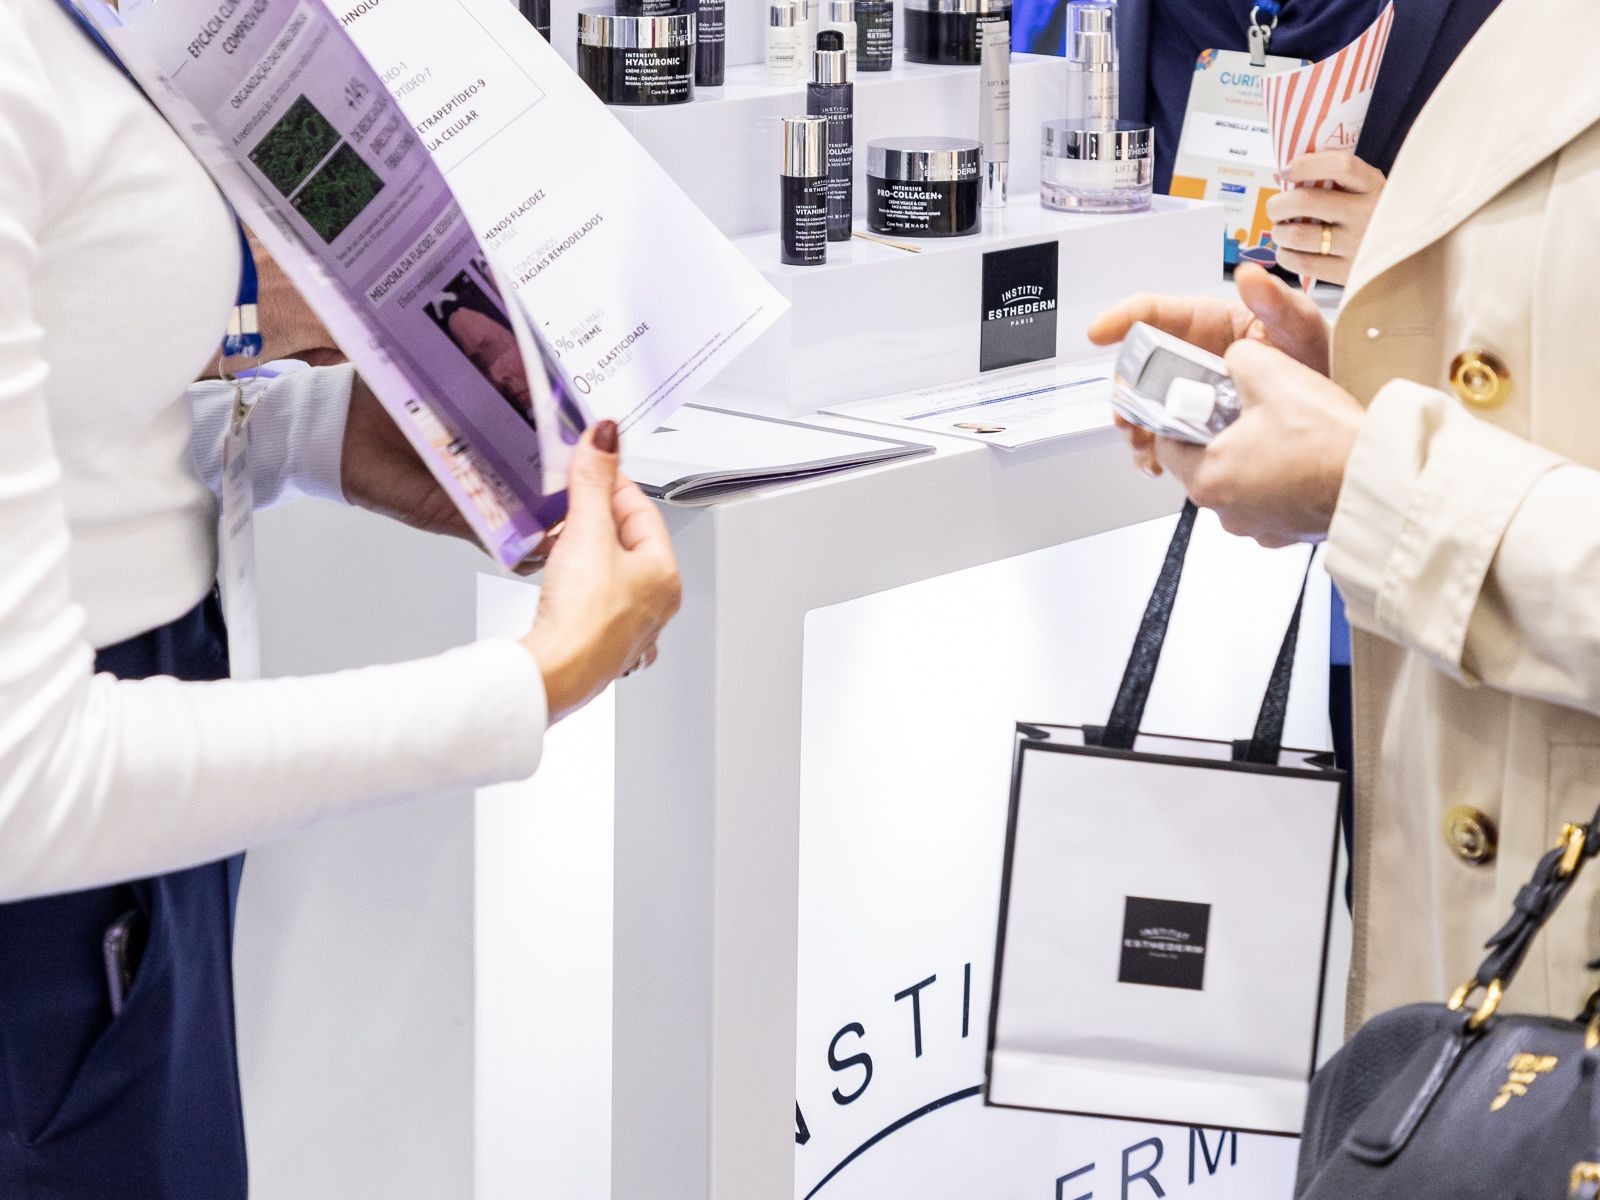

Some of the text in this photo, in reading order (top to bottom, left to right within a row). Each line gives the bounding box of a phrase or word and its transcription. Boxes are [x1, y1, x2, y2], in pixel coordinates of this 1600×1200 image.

[187, 14, 225, 58] EFICÁCIA
[625, 57, 680, 66] HYALURONIC
[230, 60, 272, 109] ORGANIZAÇÃO
[441, 110, 479, 141] CELULAR
[877, 189, 943, 200] PRO-COLLAGEN+
[483, 216, 512, 243] MENOS
[510, 189, 546, 220] FLACIDEZ
[520, 213, 603, 285] FACIAIS REMODELADOS
[369, 264, 405, 302] MELHORA
[1002, 285, 1043, 302] INSTITUT
[988, 299, 1056, 320] ESTHEDERM
[1010, 317, 1034, 326] PARIS
[578, 324, 603, 347] FIRME
[597, 321, 650, 369] ELASTICIDADE
